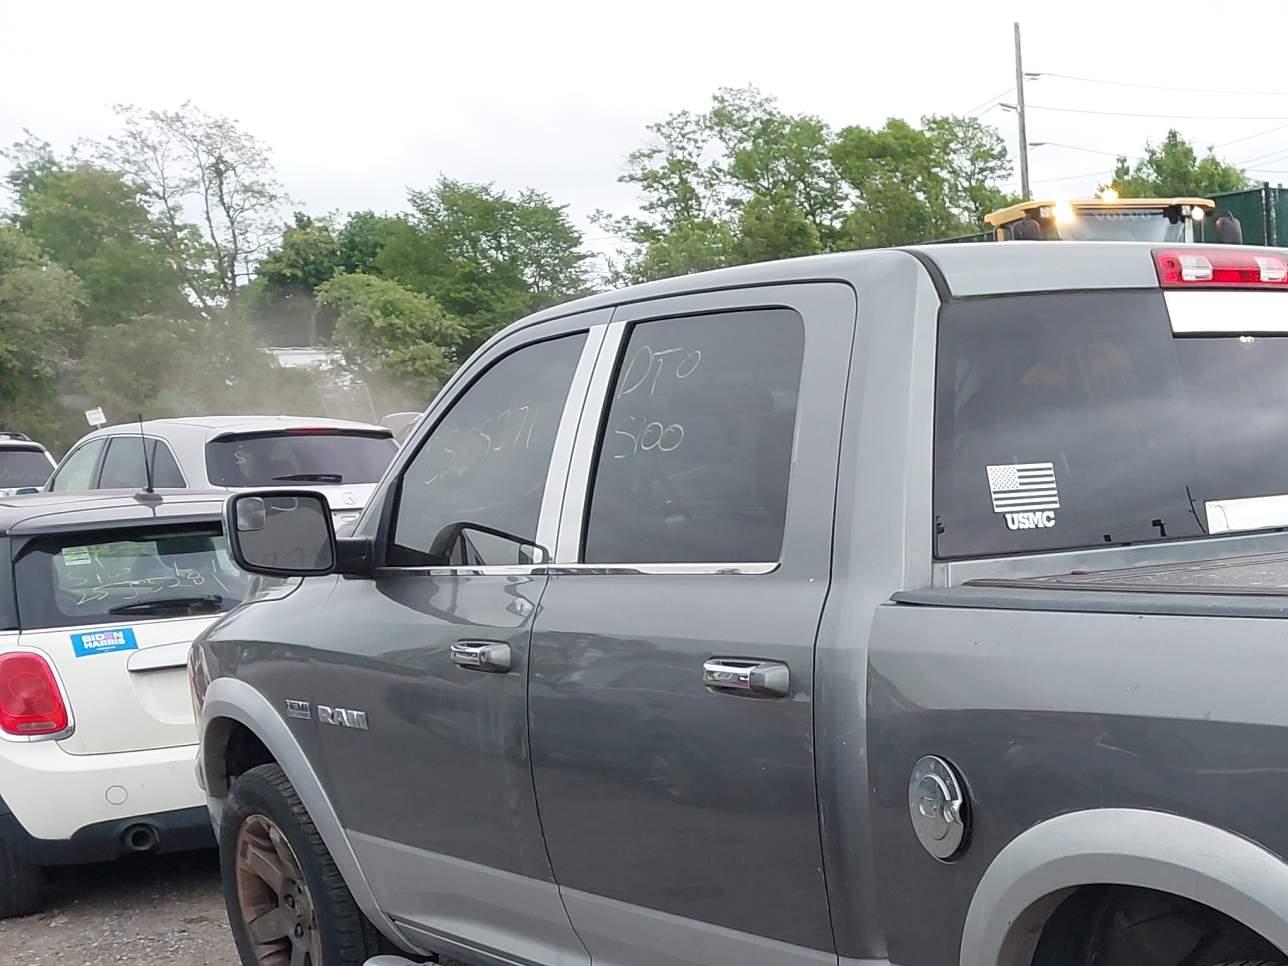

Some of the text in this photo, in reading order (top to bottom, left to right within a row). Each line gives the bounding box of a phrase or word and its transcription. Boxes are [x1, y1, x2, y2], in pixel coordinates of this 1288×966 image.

[617, 344, 702, 400] DTO
[1004, 510, 1056, 530] USMC
[81, 631, 124, 643] BIDEN
[83, 638, 126, 650] HARRIS
[317, 705, 368, 730] RAM
